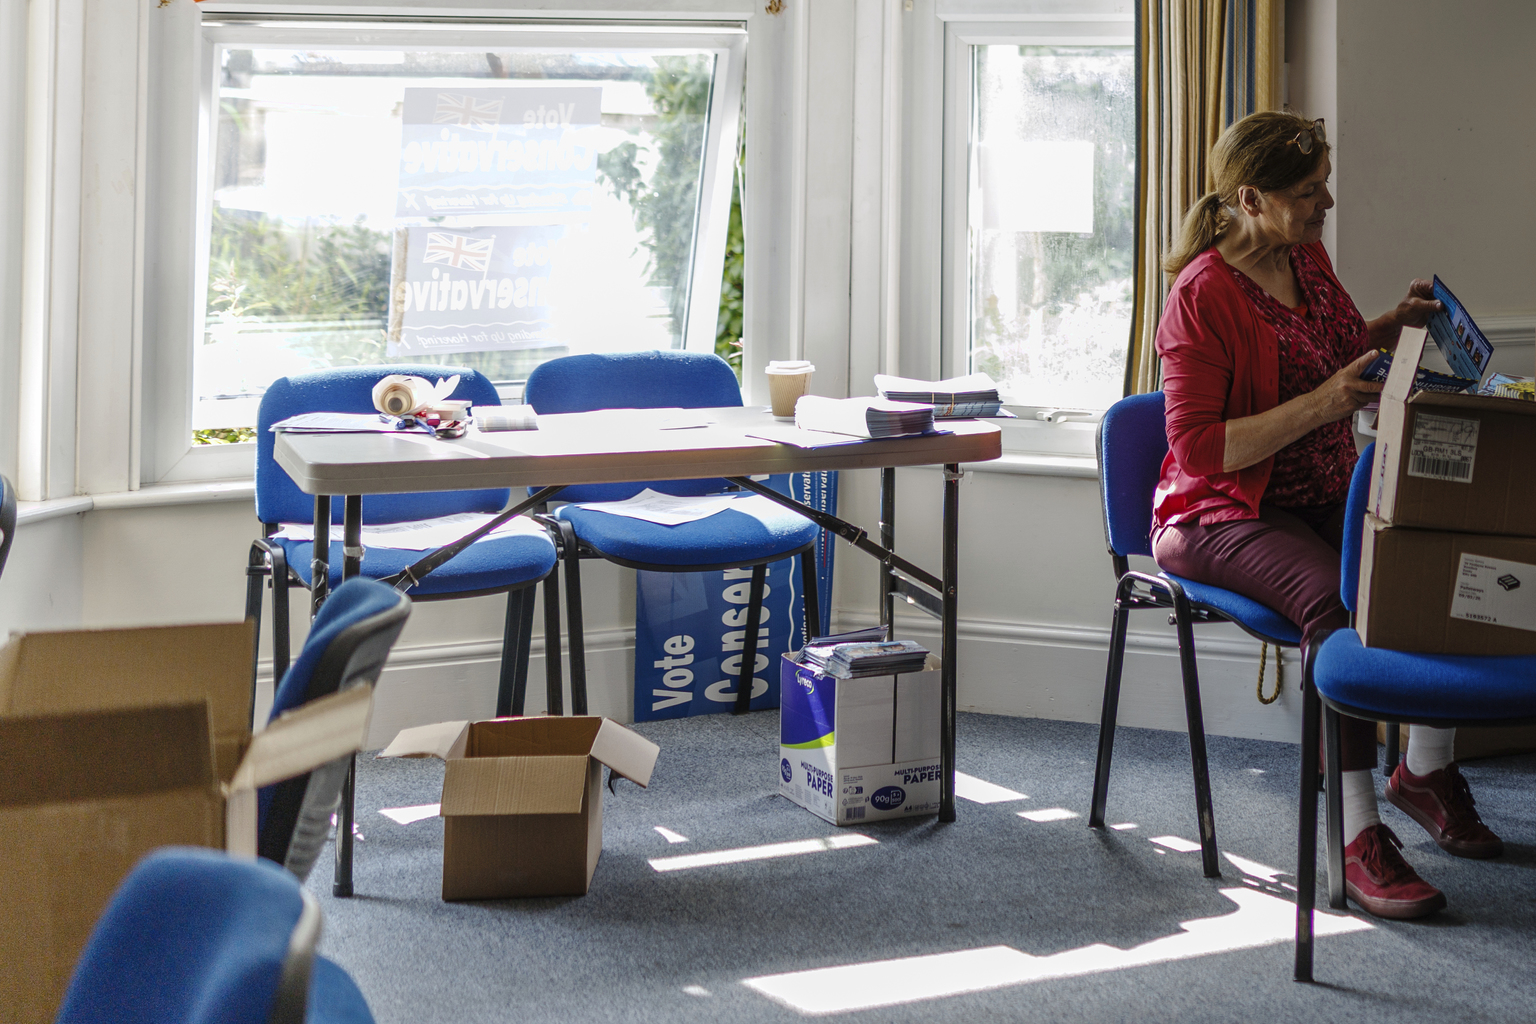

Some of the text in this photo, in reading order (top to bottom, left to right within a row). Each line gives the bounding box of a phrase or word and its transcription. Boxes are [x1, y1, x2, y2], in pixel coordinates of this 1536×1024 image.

[703, 563, 772, 703] Conser
[651, 633, 696, 712] Vote
[796, 673, 813, 689] Lyreco
[800, 760, 834, 783] MULTI-PURPOSE
[903, 770, 941, 785] PAPER
[806, 771, 833, 798] PAPER
[875, 795, 890, 804] 90g
